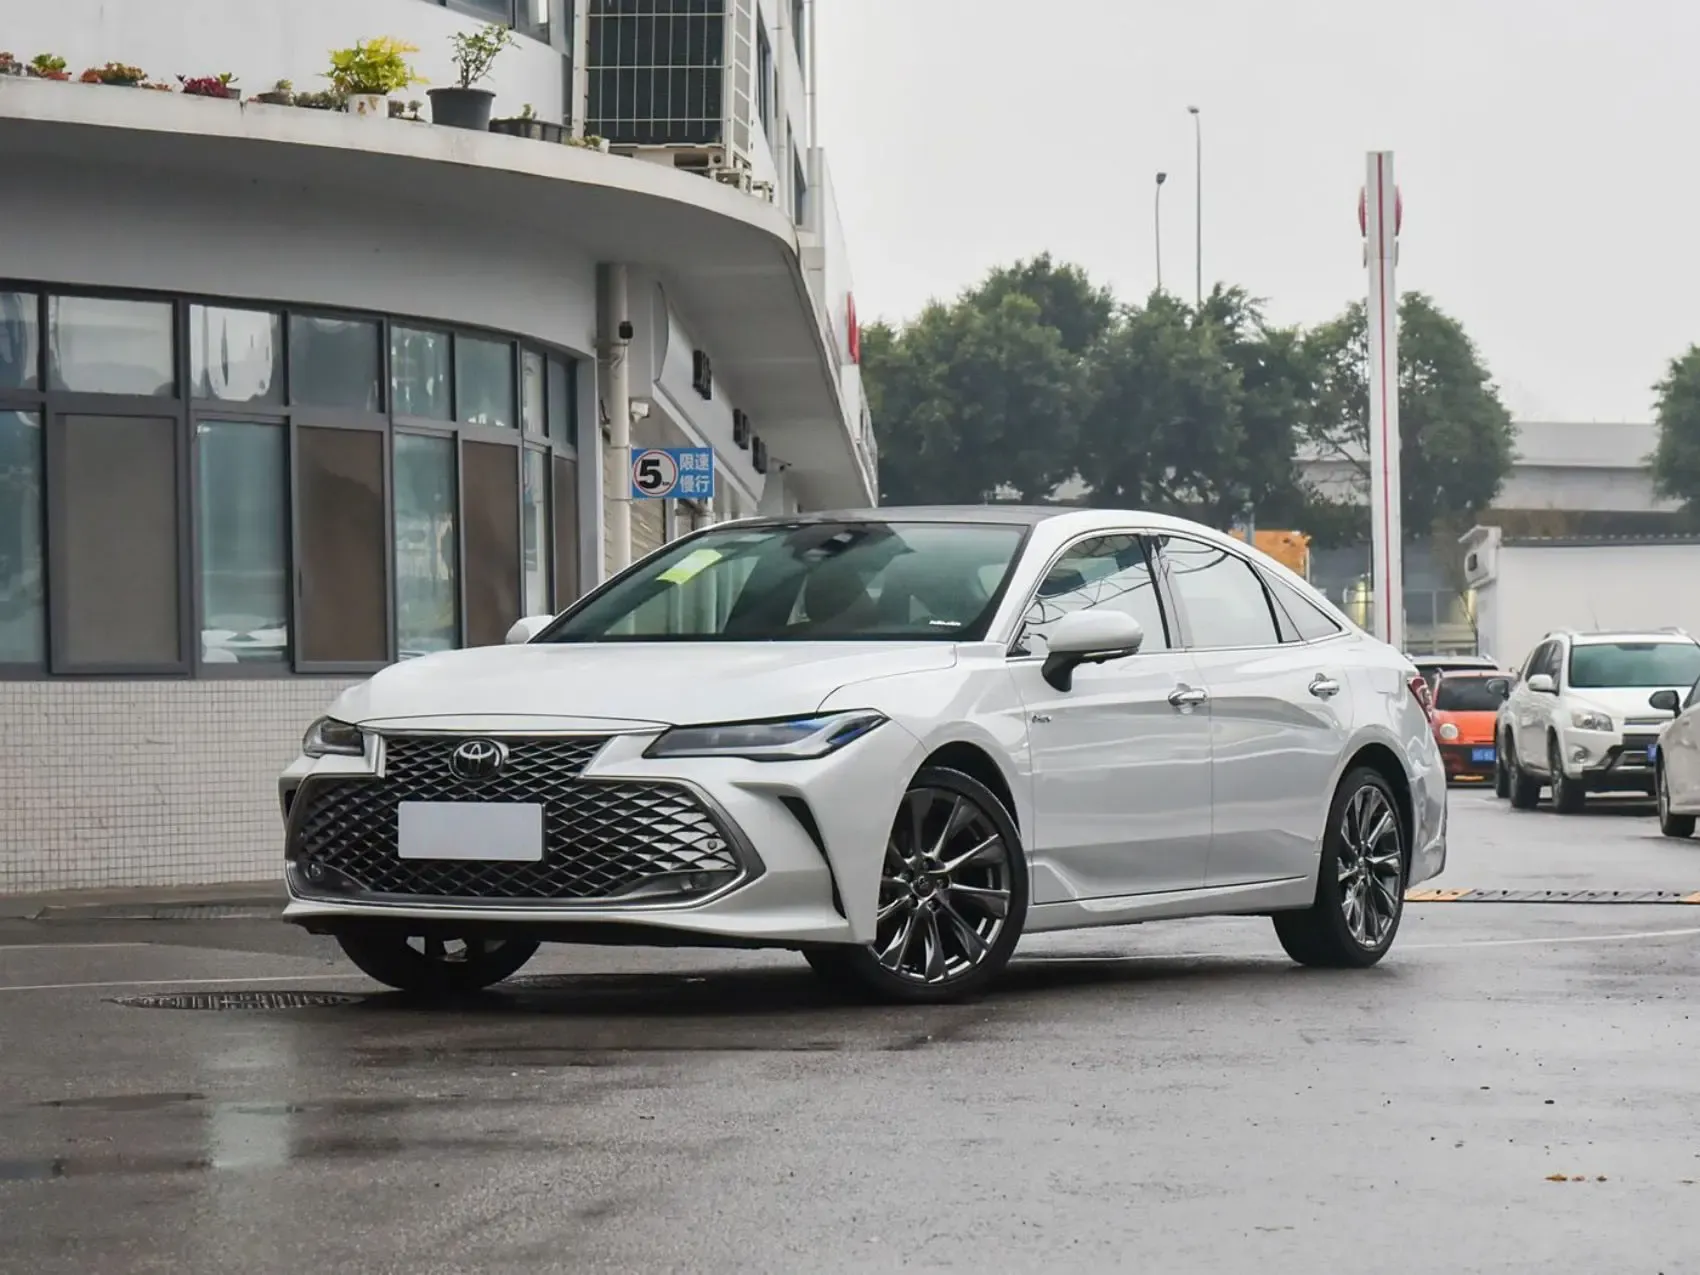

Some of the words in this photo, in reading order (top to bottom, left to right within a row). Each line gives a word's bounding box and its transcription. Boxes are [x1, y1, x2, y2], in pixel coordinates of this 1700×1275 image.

[680, 453, 709, 470] 限速
[640, 459, 662, 488] 5
[680, 475, 710, 492] 慢行
